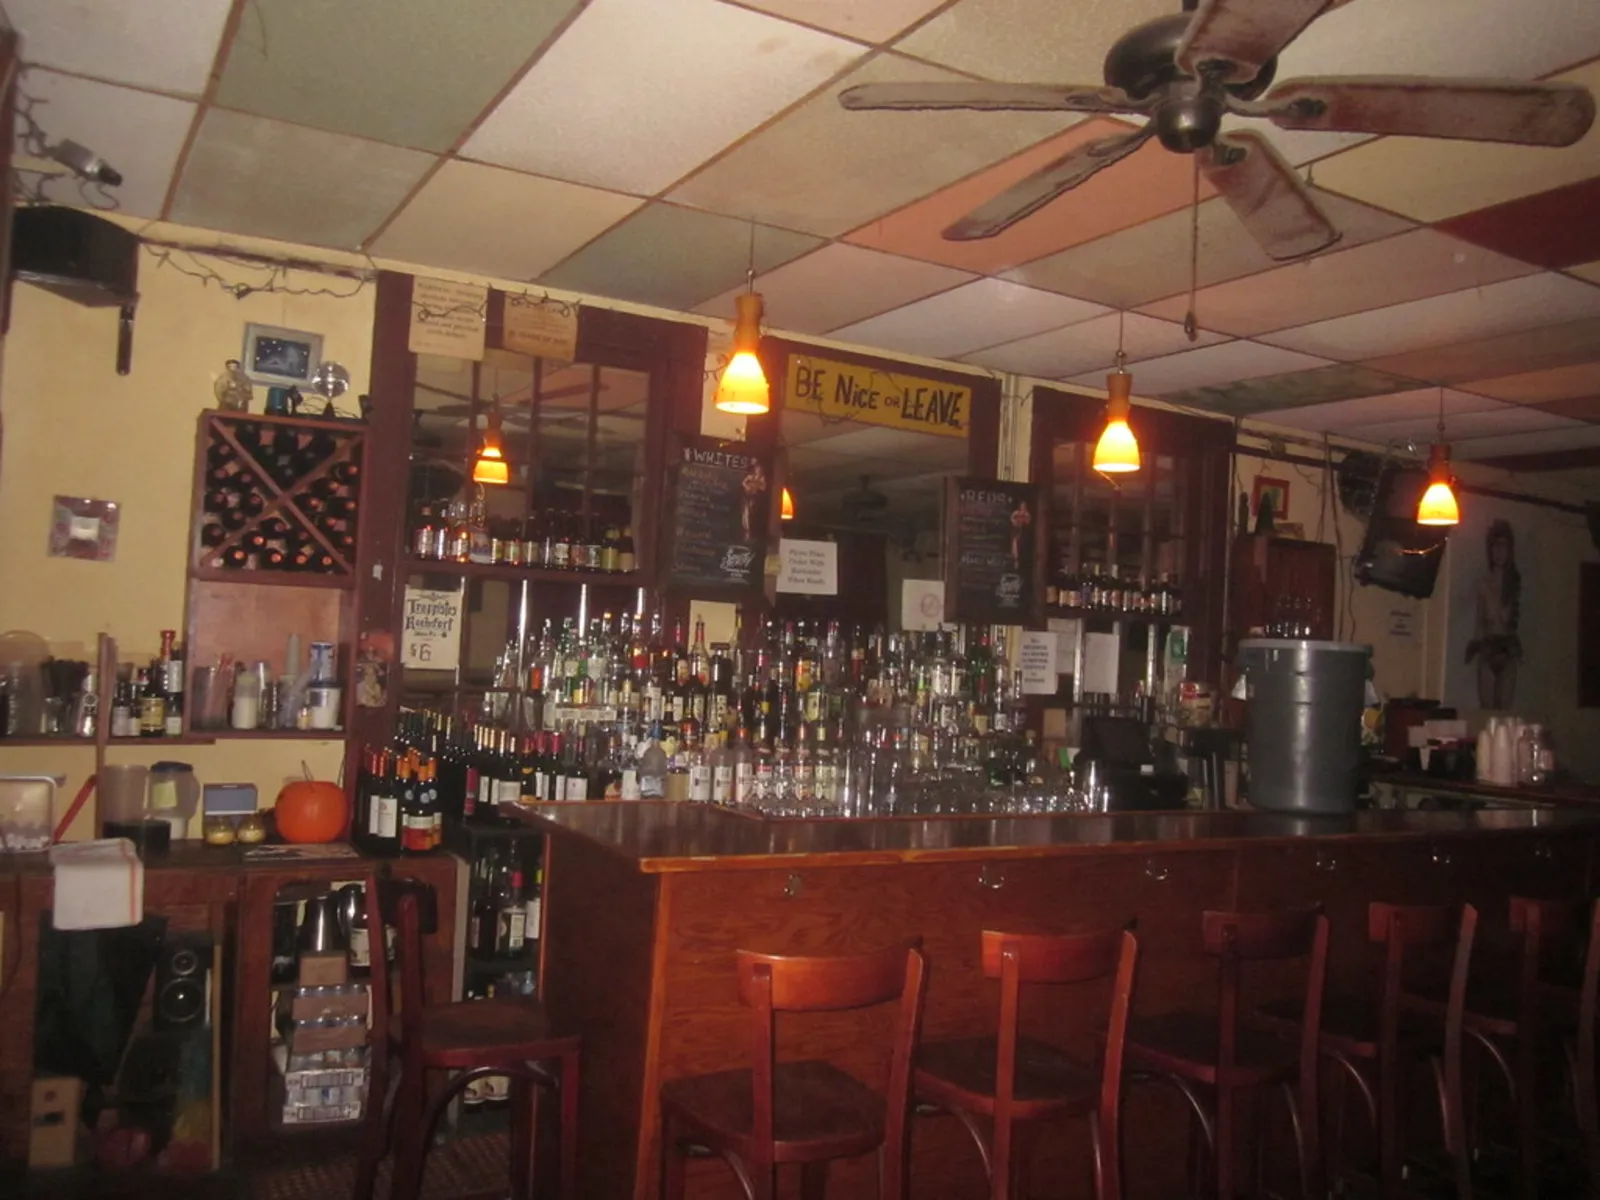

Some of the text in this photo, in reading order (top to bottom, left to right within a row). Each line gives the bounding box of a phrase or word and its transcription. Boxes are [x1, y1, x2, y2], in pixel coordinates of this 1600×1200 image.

[795, 366, 826, 401] BE
[900, 387, 964, 430] LEAVE
[693, 448, 749, 469] WHITES
